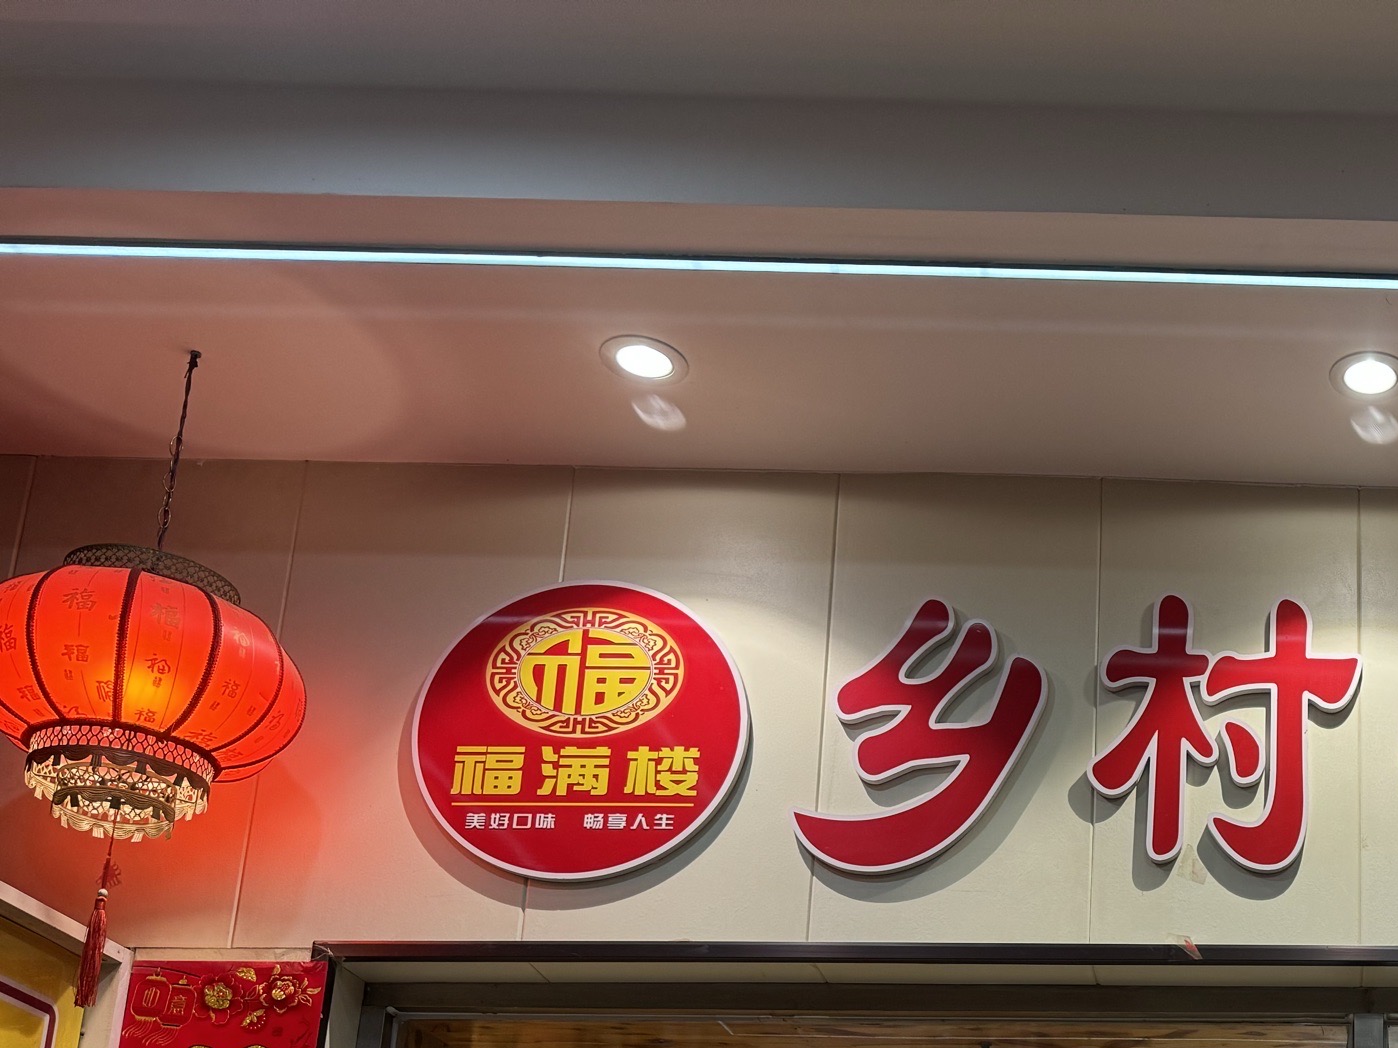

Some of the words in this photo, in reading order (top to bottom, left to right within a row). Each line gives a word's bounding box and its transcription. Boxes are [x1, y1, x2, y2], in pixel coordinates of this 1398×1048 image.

[519, 629, 652, 716] 福
[450, 745, 701, 796] 福满楼
[464, 812, 556, 831] 美好口味
[582, 812, 676, 831] 畅享人生
